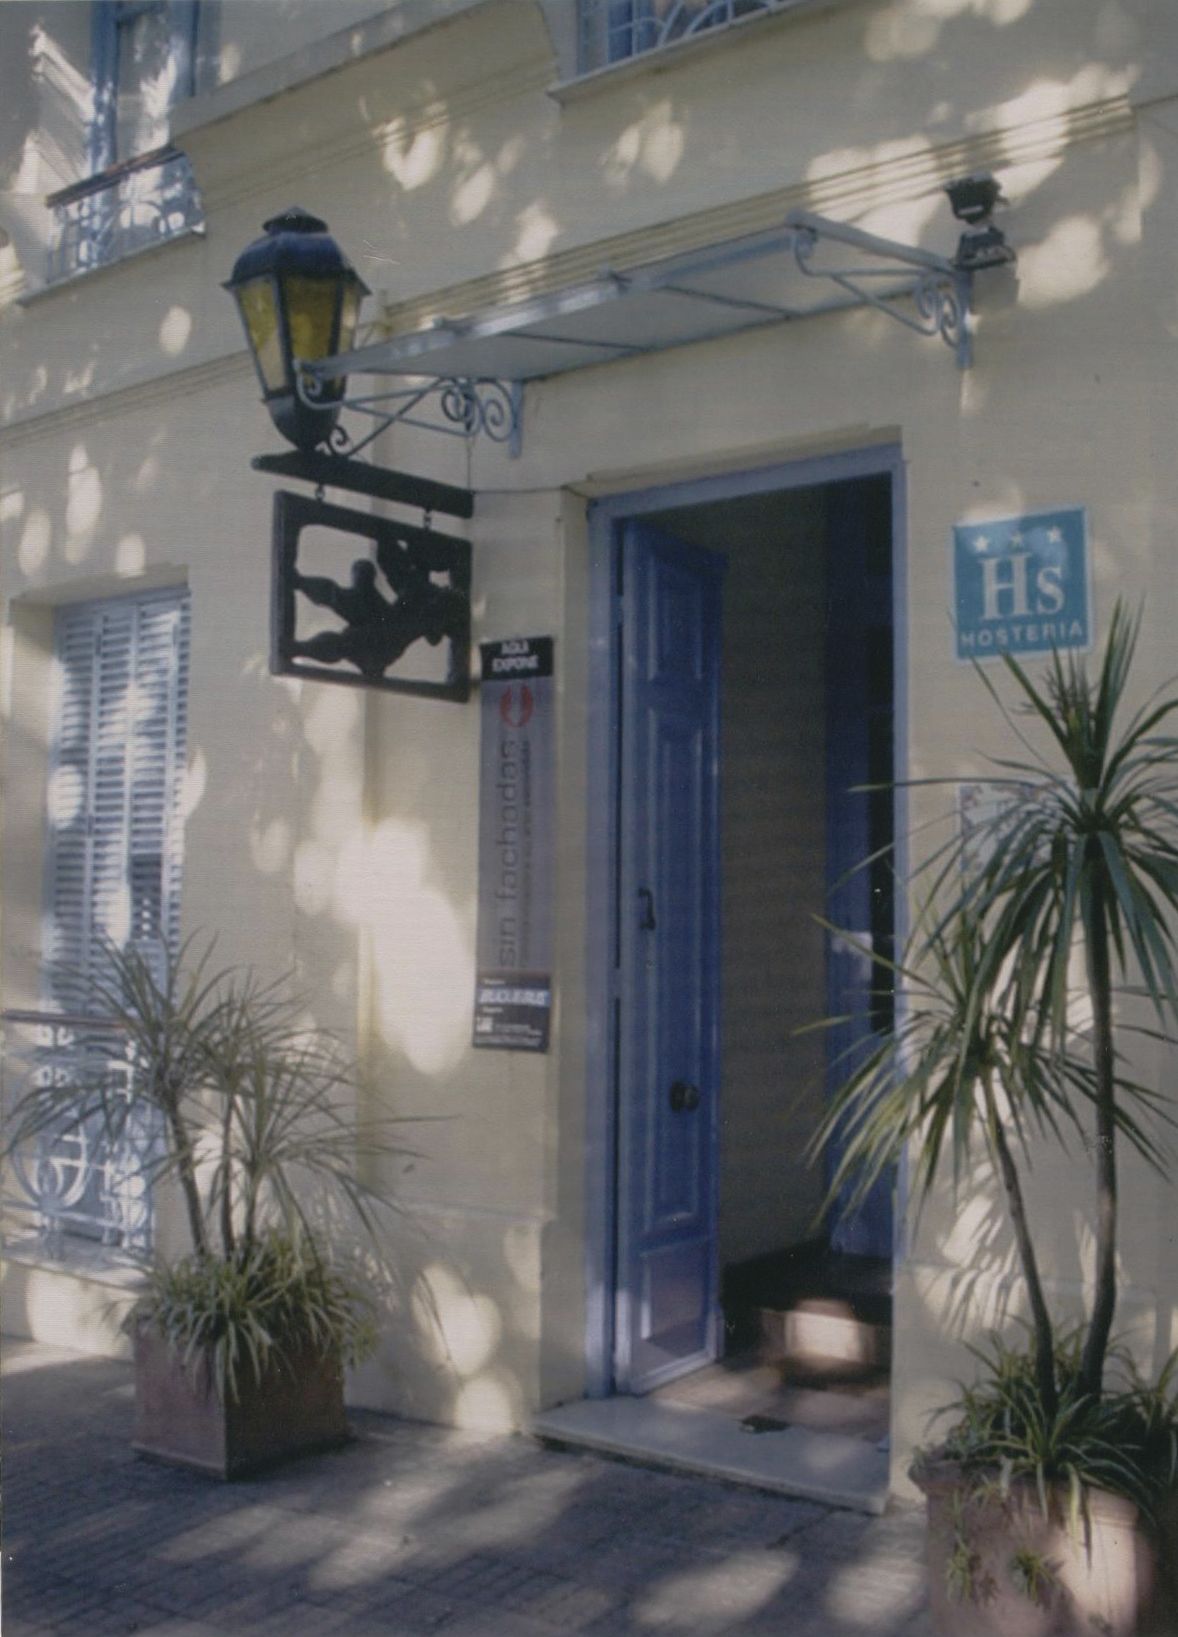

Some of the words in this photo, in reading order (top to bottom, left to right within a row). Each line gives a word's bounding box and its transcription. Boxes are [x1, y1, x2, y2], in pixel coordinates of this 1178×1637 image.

[980, 554, 1065, 618] Hs
[961, 621, 1082, 646] HOSTERIA
[494, 740, 517, 900] fachadas
